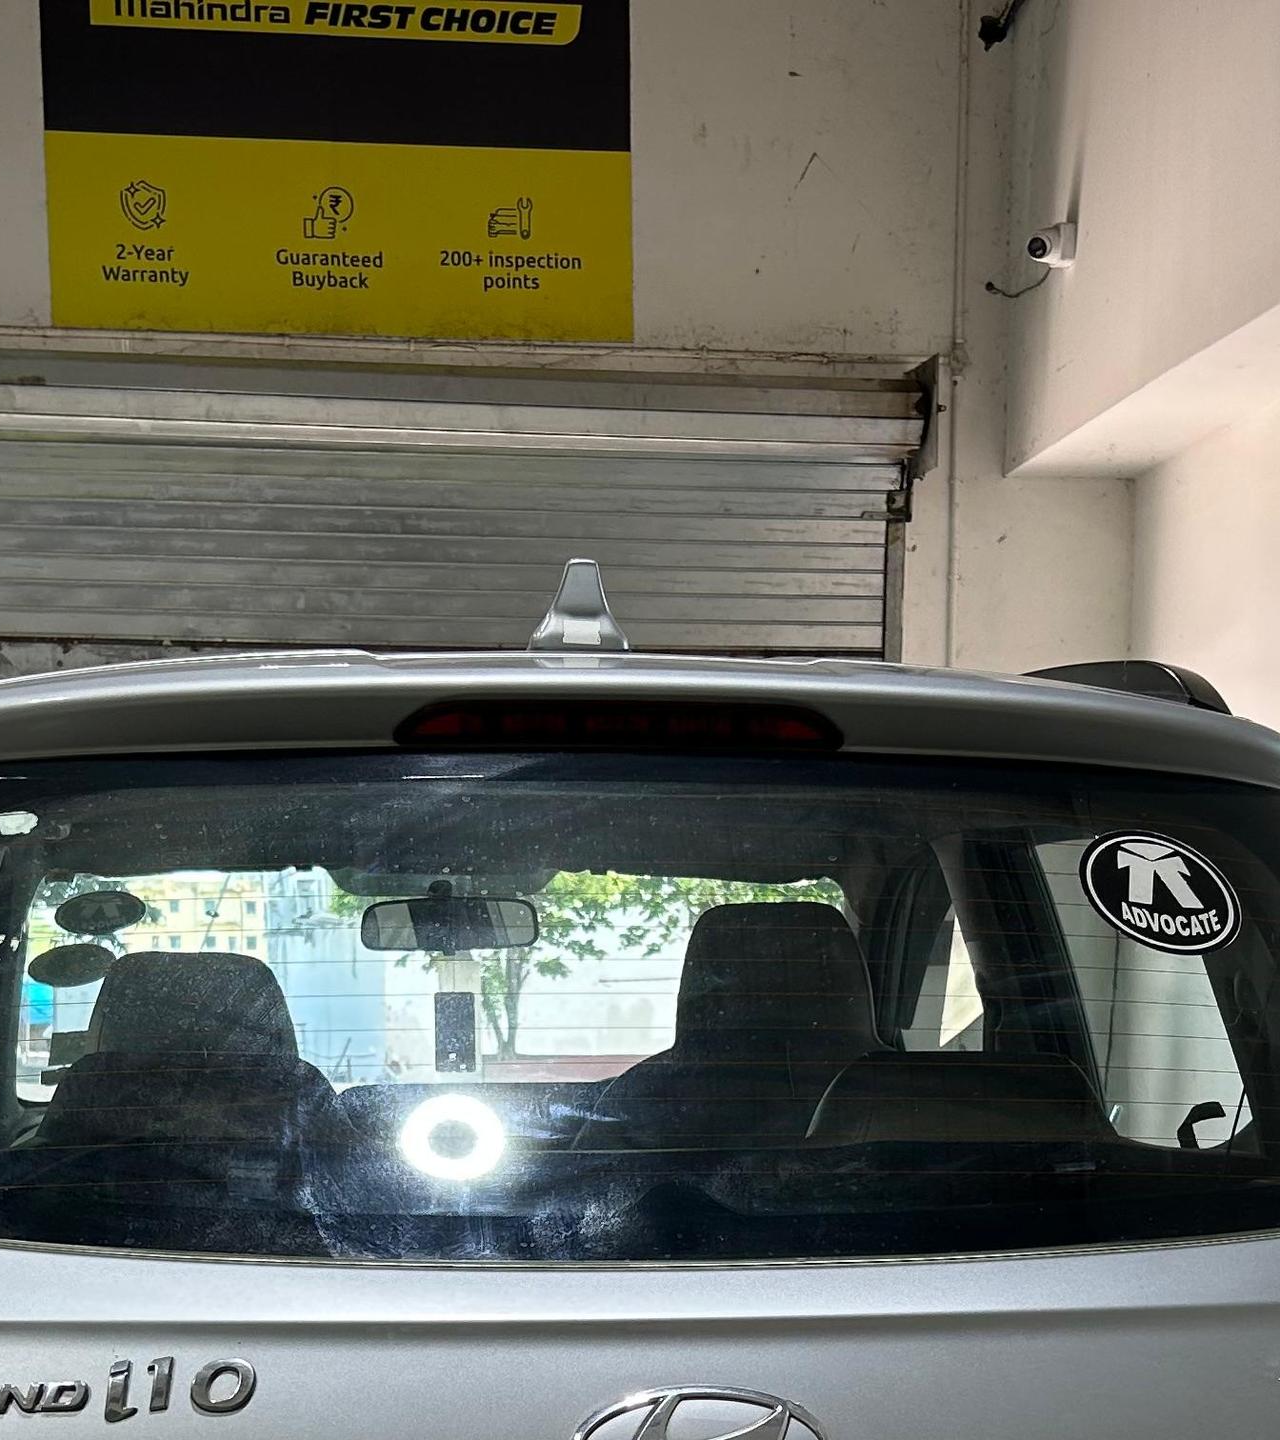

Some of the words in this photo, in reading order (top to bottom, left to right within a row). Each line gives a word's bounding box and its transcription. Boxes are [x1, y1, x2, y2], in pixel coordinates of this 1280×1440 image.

[305, 2, 416, 30] FIRST
[420, 7, 558, 36] CHOICE
[115, 244, 174, 262] 2-Year
[276, 249, 383, 268] Guaranteed
[440, 251, 483, 267] 200+
[489, 251, 582, 273] inspection
[102, 265, 189, 287] Warranty
[292, 271, 369, 290] Buyback
[483, 273, 540, 292] points
[1121, 901, 1222, 937] ADVOCATE
